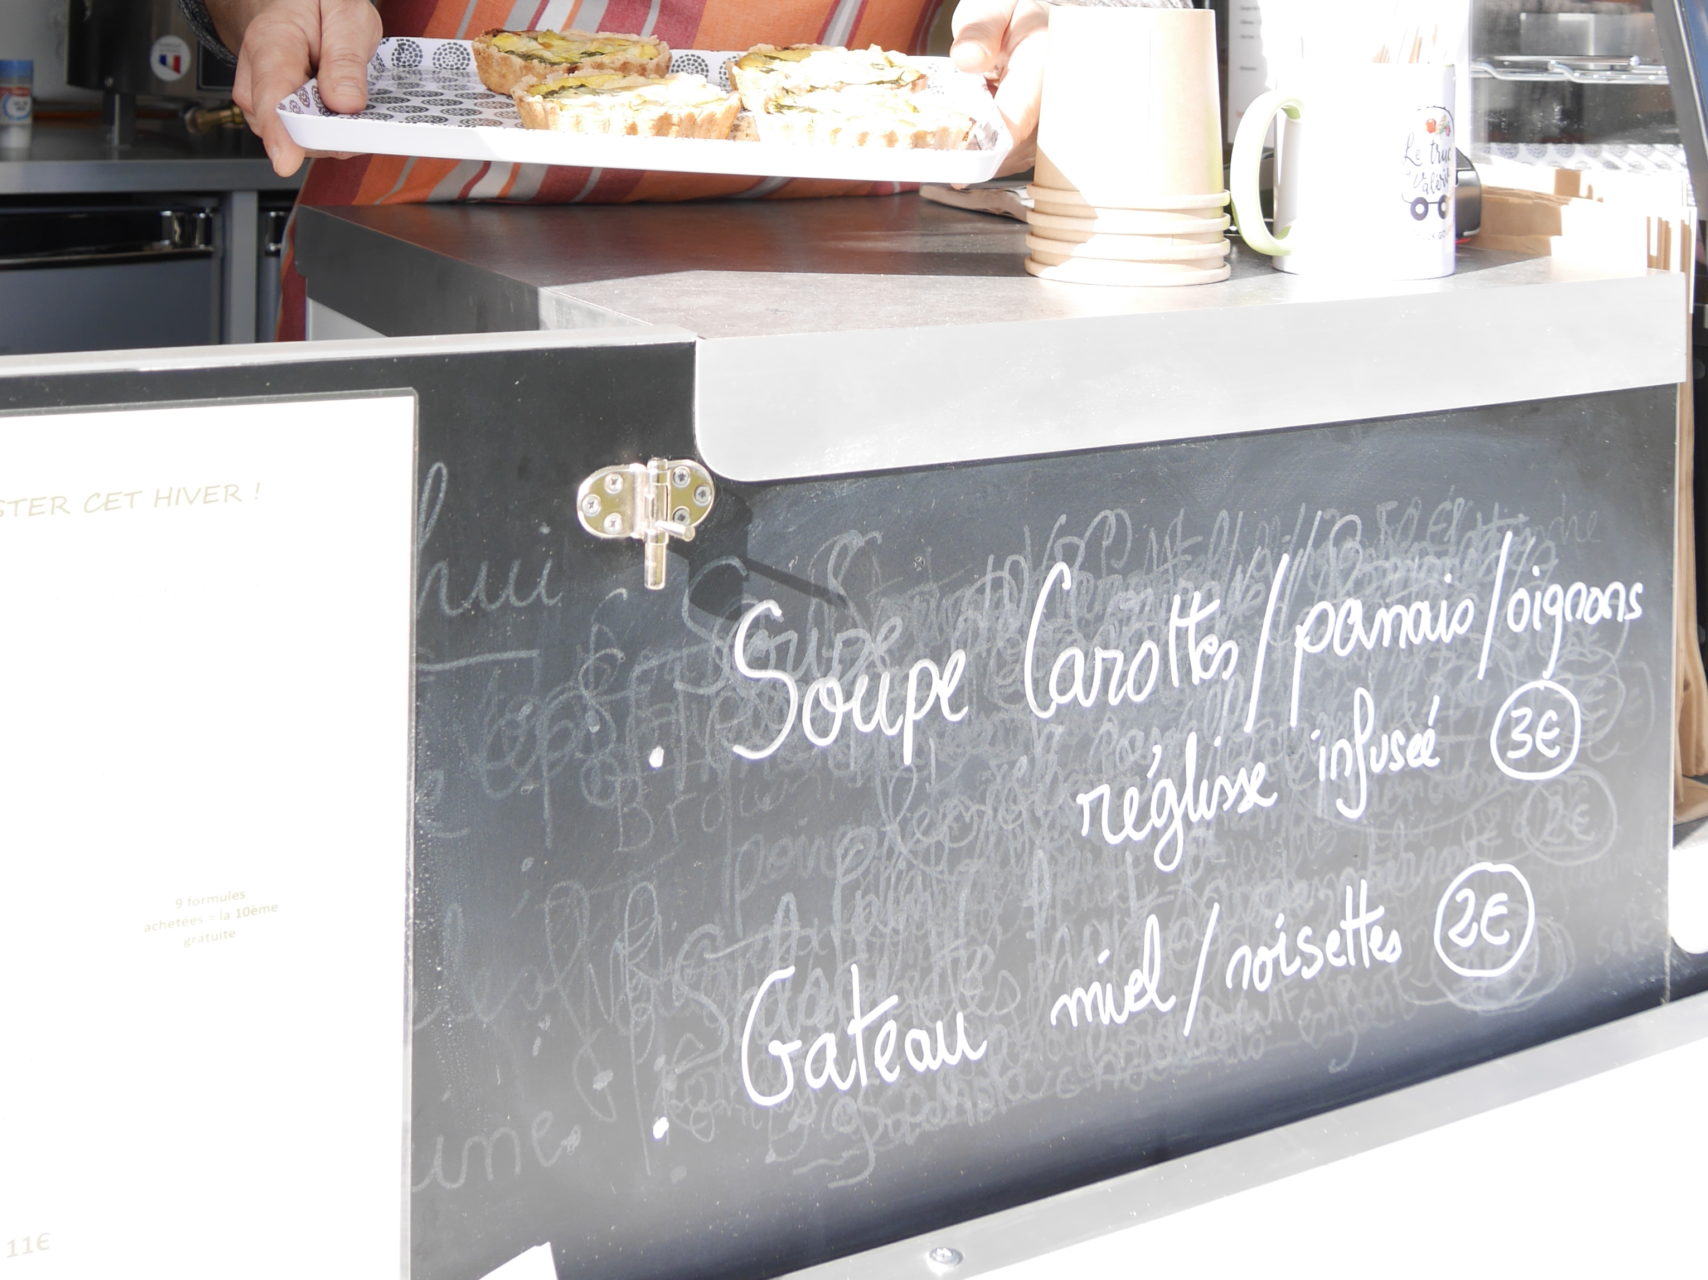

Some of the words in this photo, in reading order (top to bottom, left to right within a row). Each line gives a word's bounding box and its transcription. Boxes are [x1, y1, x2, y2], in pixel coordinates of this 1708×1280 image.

[83, 490, 144, 514] CET
[152, 482, 243, 509] HIVER
[733, 601, 968, 766] Soupe
[1506, 707, 1561, 759] 3€
[187, 889, 246, 907] formules
[219, 908, 231, 921] la
[1447, 888, 1510, 948] 2€
[183, 928, 237, 949] gratuite
[6, 1231, 52, 1260] 11€
